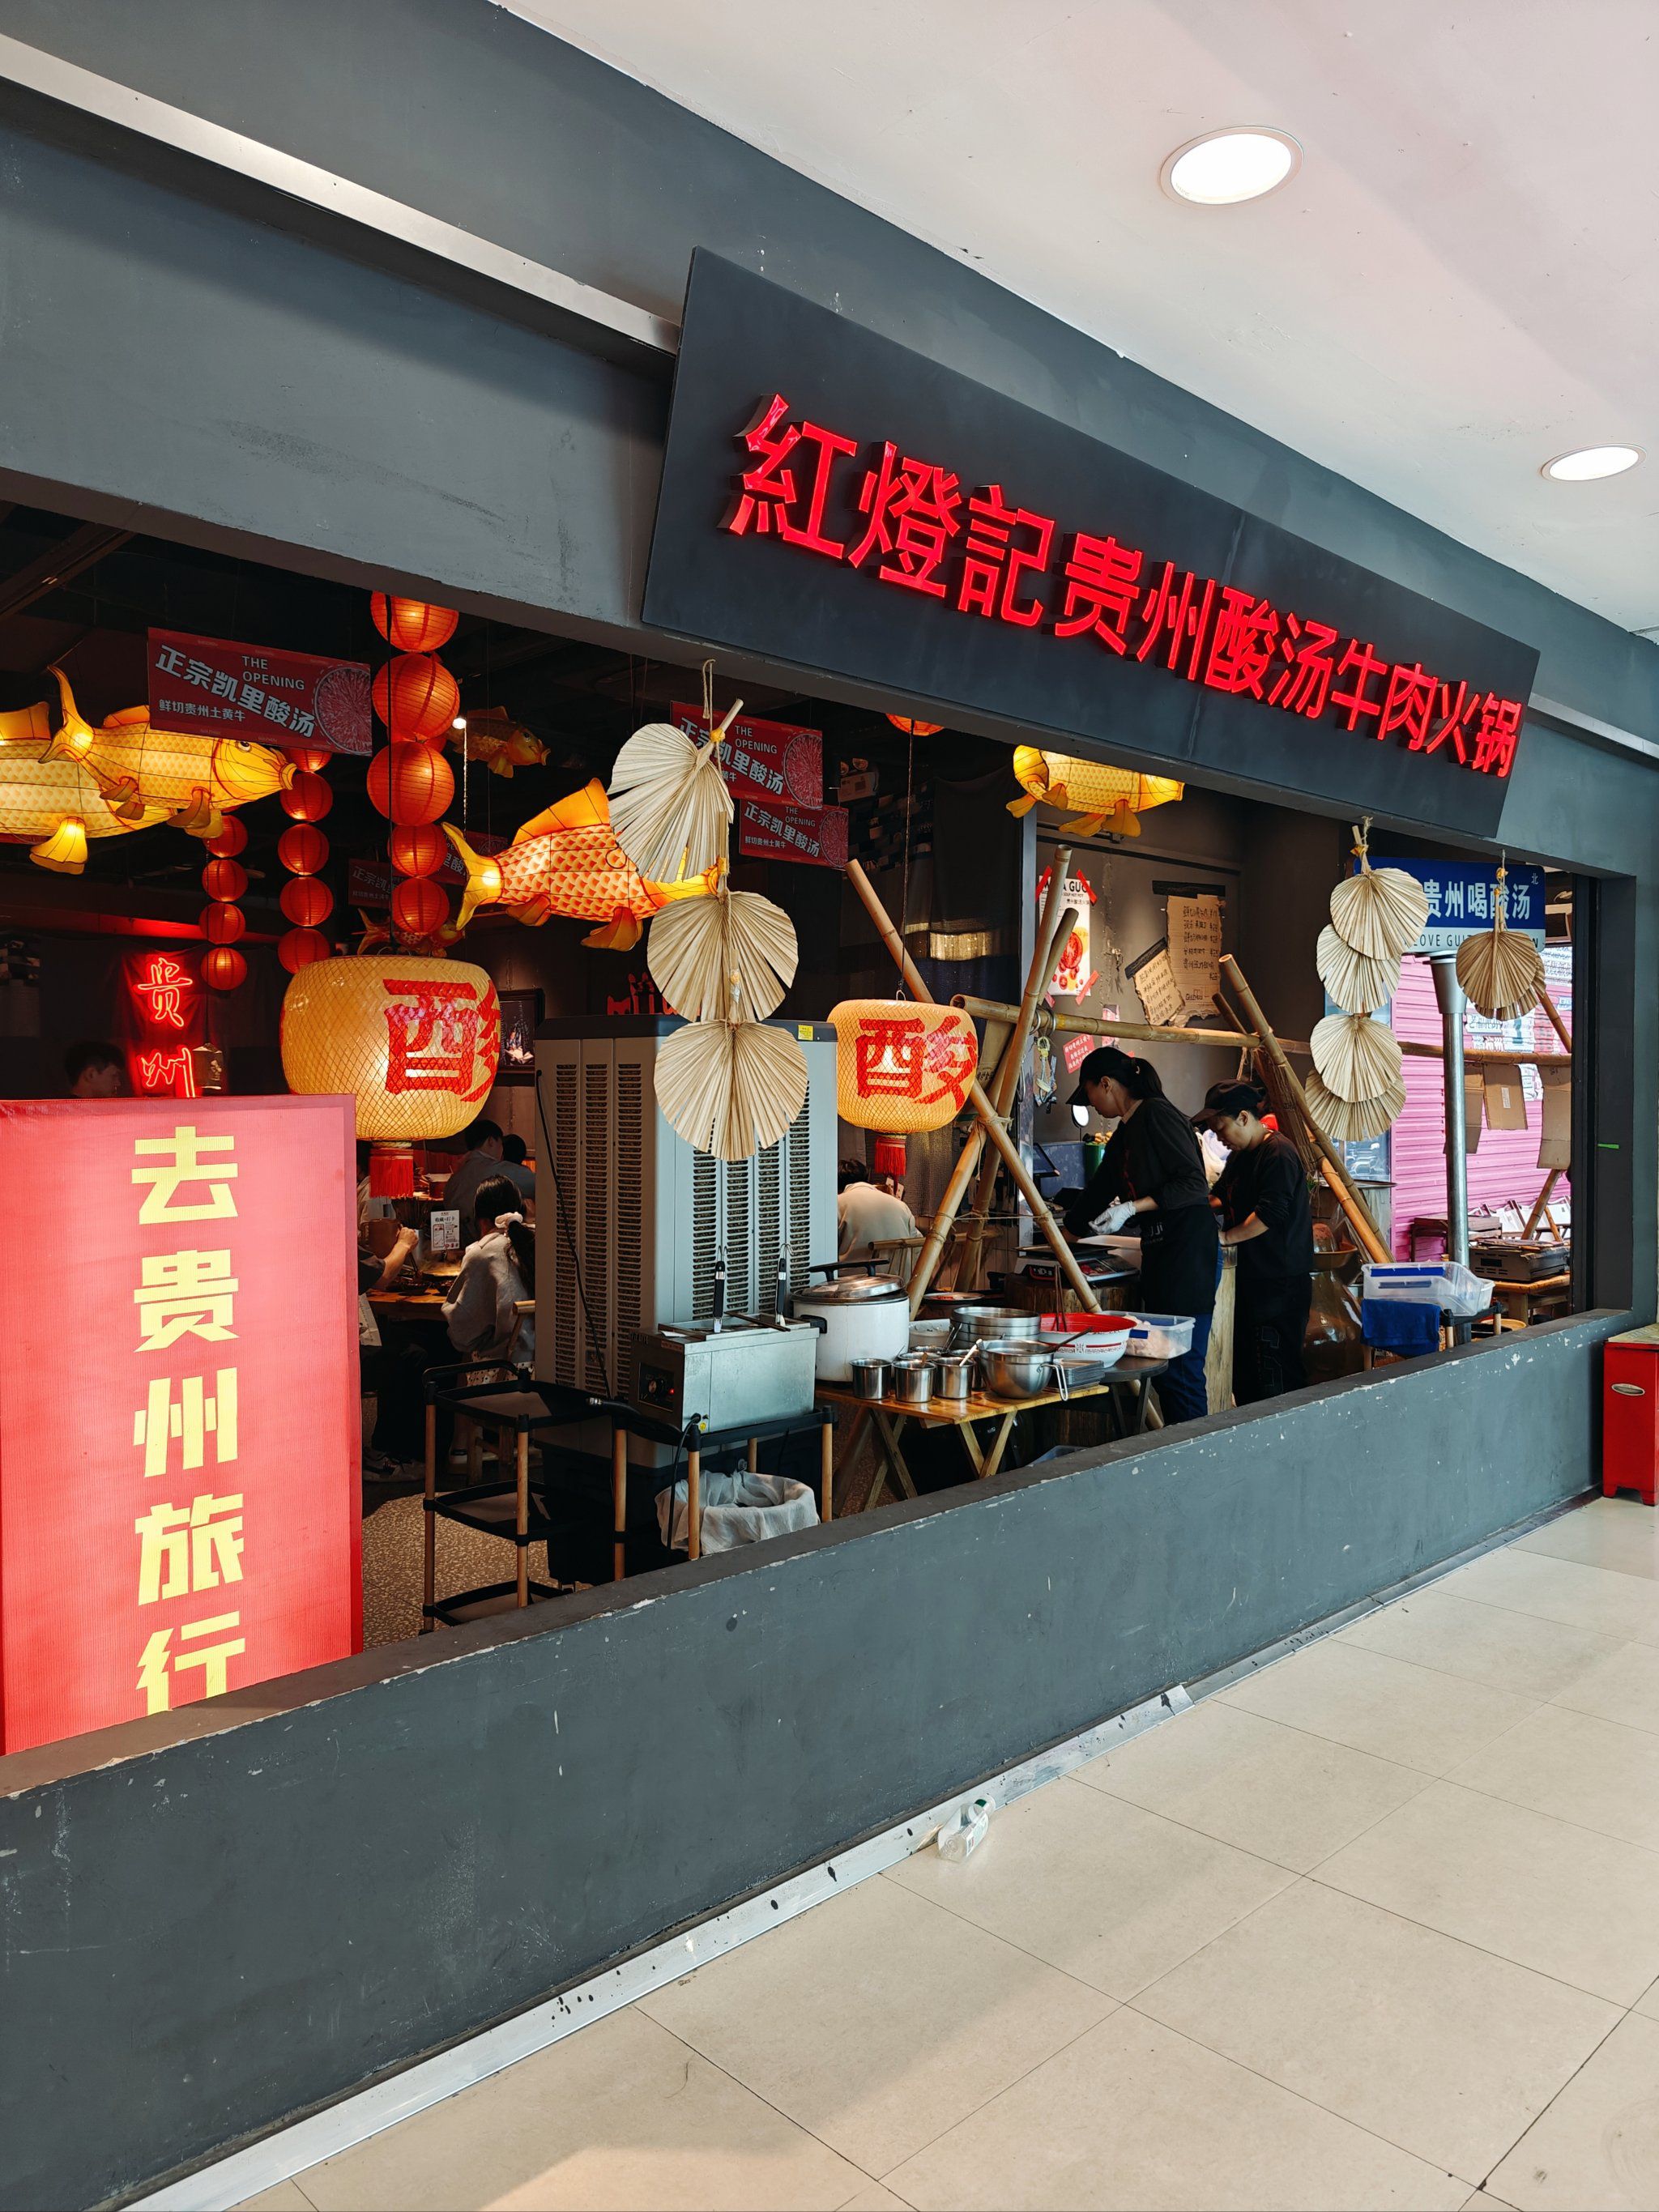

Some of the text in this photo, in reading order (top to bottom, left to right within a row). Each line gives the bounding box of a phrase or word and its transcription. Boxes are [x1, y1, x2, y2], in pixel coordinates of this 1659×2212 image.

[242, 655, 268, 670] THE
[242, 671, 305, 690] OPENING
[155, 645, 318, 738] 正宗凯里酸汤
[159, 699, 245, 722] 鲜切贵州土黄牛
[735, 725, 753, 737] THE
[735, 739, 778, 754] OPENING
[785, 806, 798, 815] THE
[744, 801, 821, 858] 正宗凯里酸汤
[785, 816, 816, 827] OPENING
[855, 1015, 978, 1111] 酸
[131, 1125, 246, 1716] 去贵州旅行
